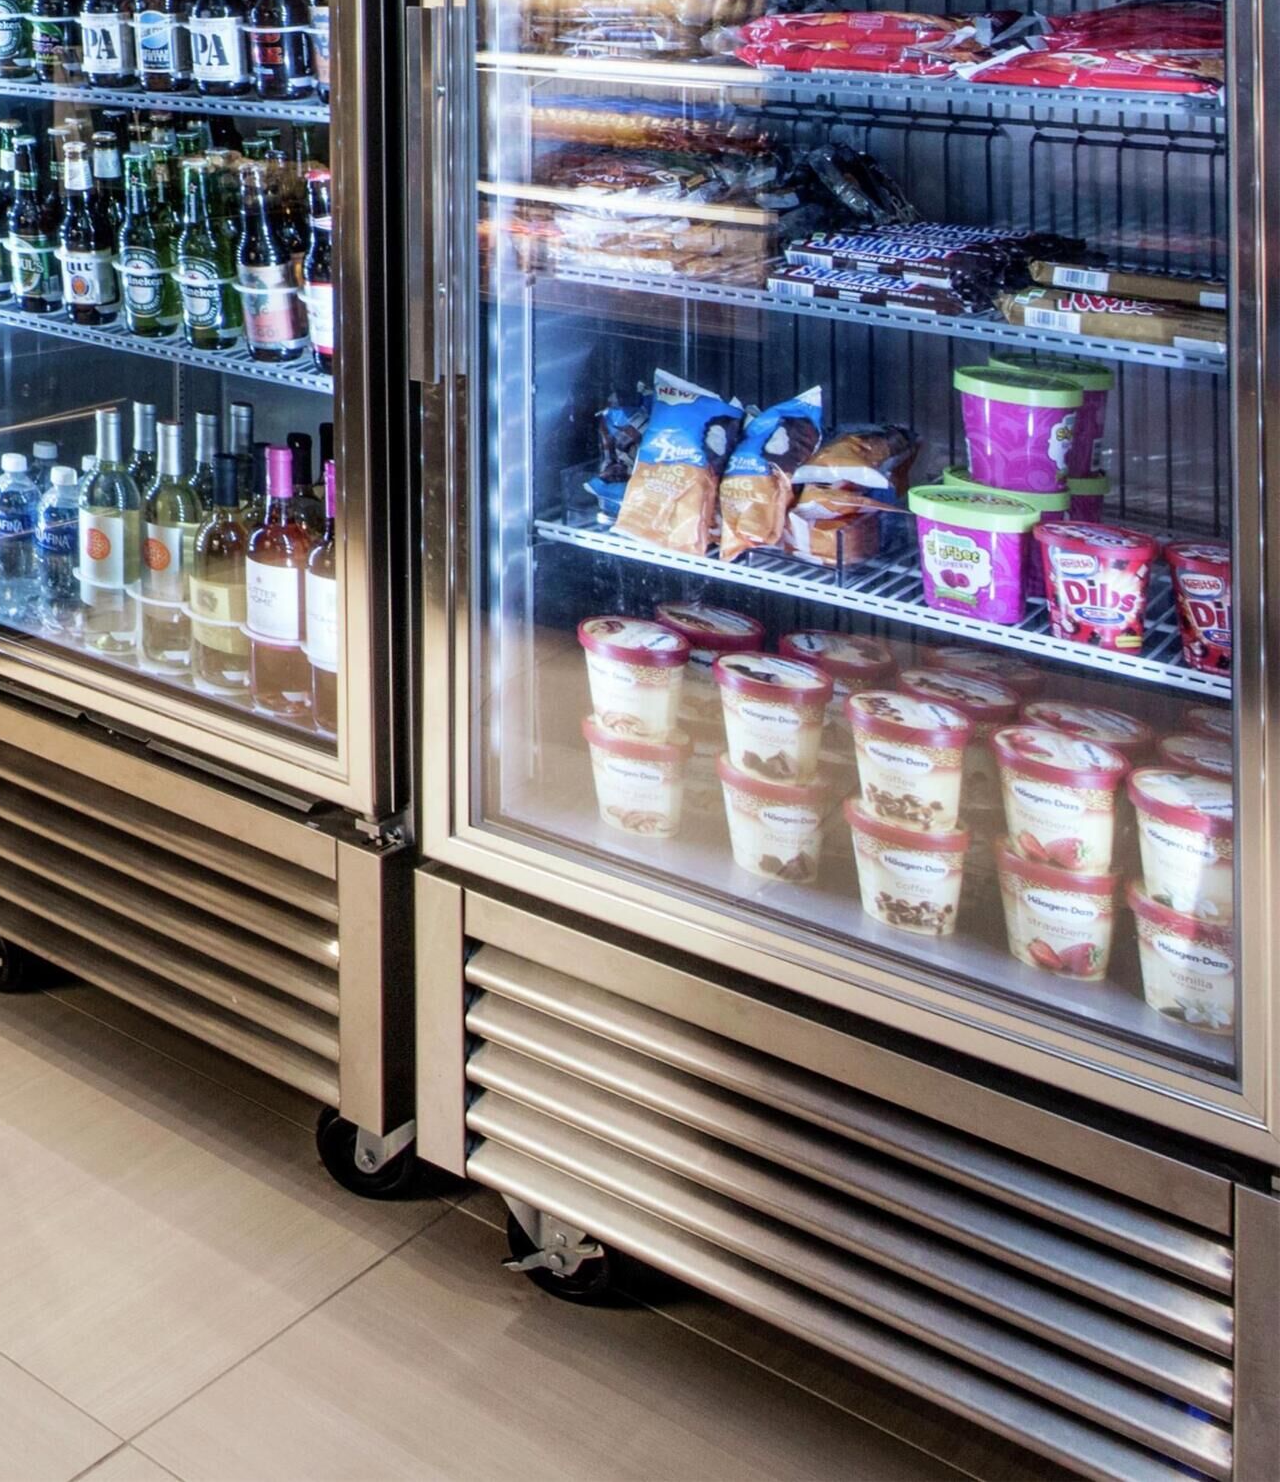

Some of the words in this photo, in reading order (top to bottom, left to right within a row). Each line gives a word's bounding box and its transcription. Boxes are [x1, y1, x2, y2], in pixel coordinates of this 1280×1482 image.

[84, 27, 119, 61] PA
[192, 32, 228, 67] PA
[832, 251, 848, 259] ICE
[848, 253, 876, 262] CREAM
[877, 256, 897, 265] BAR
[789, 265, 922, 291] SNICKERS
[814, 279, 829, 287] ICE
[830, 281, 859, 290] CREAM
[860, 286, 880, 294] BAR
[1062, 579, 1137, 612] Dibs
[1026, 917, 1093, 940] strawberry
[1170, 969, 1214, 990] vanilla
